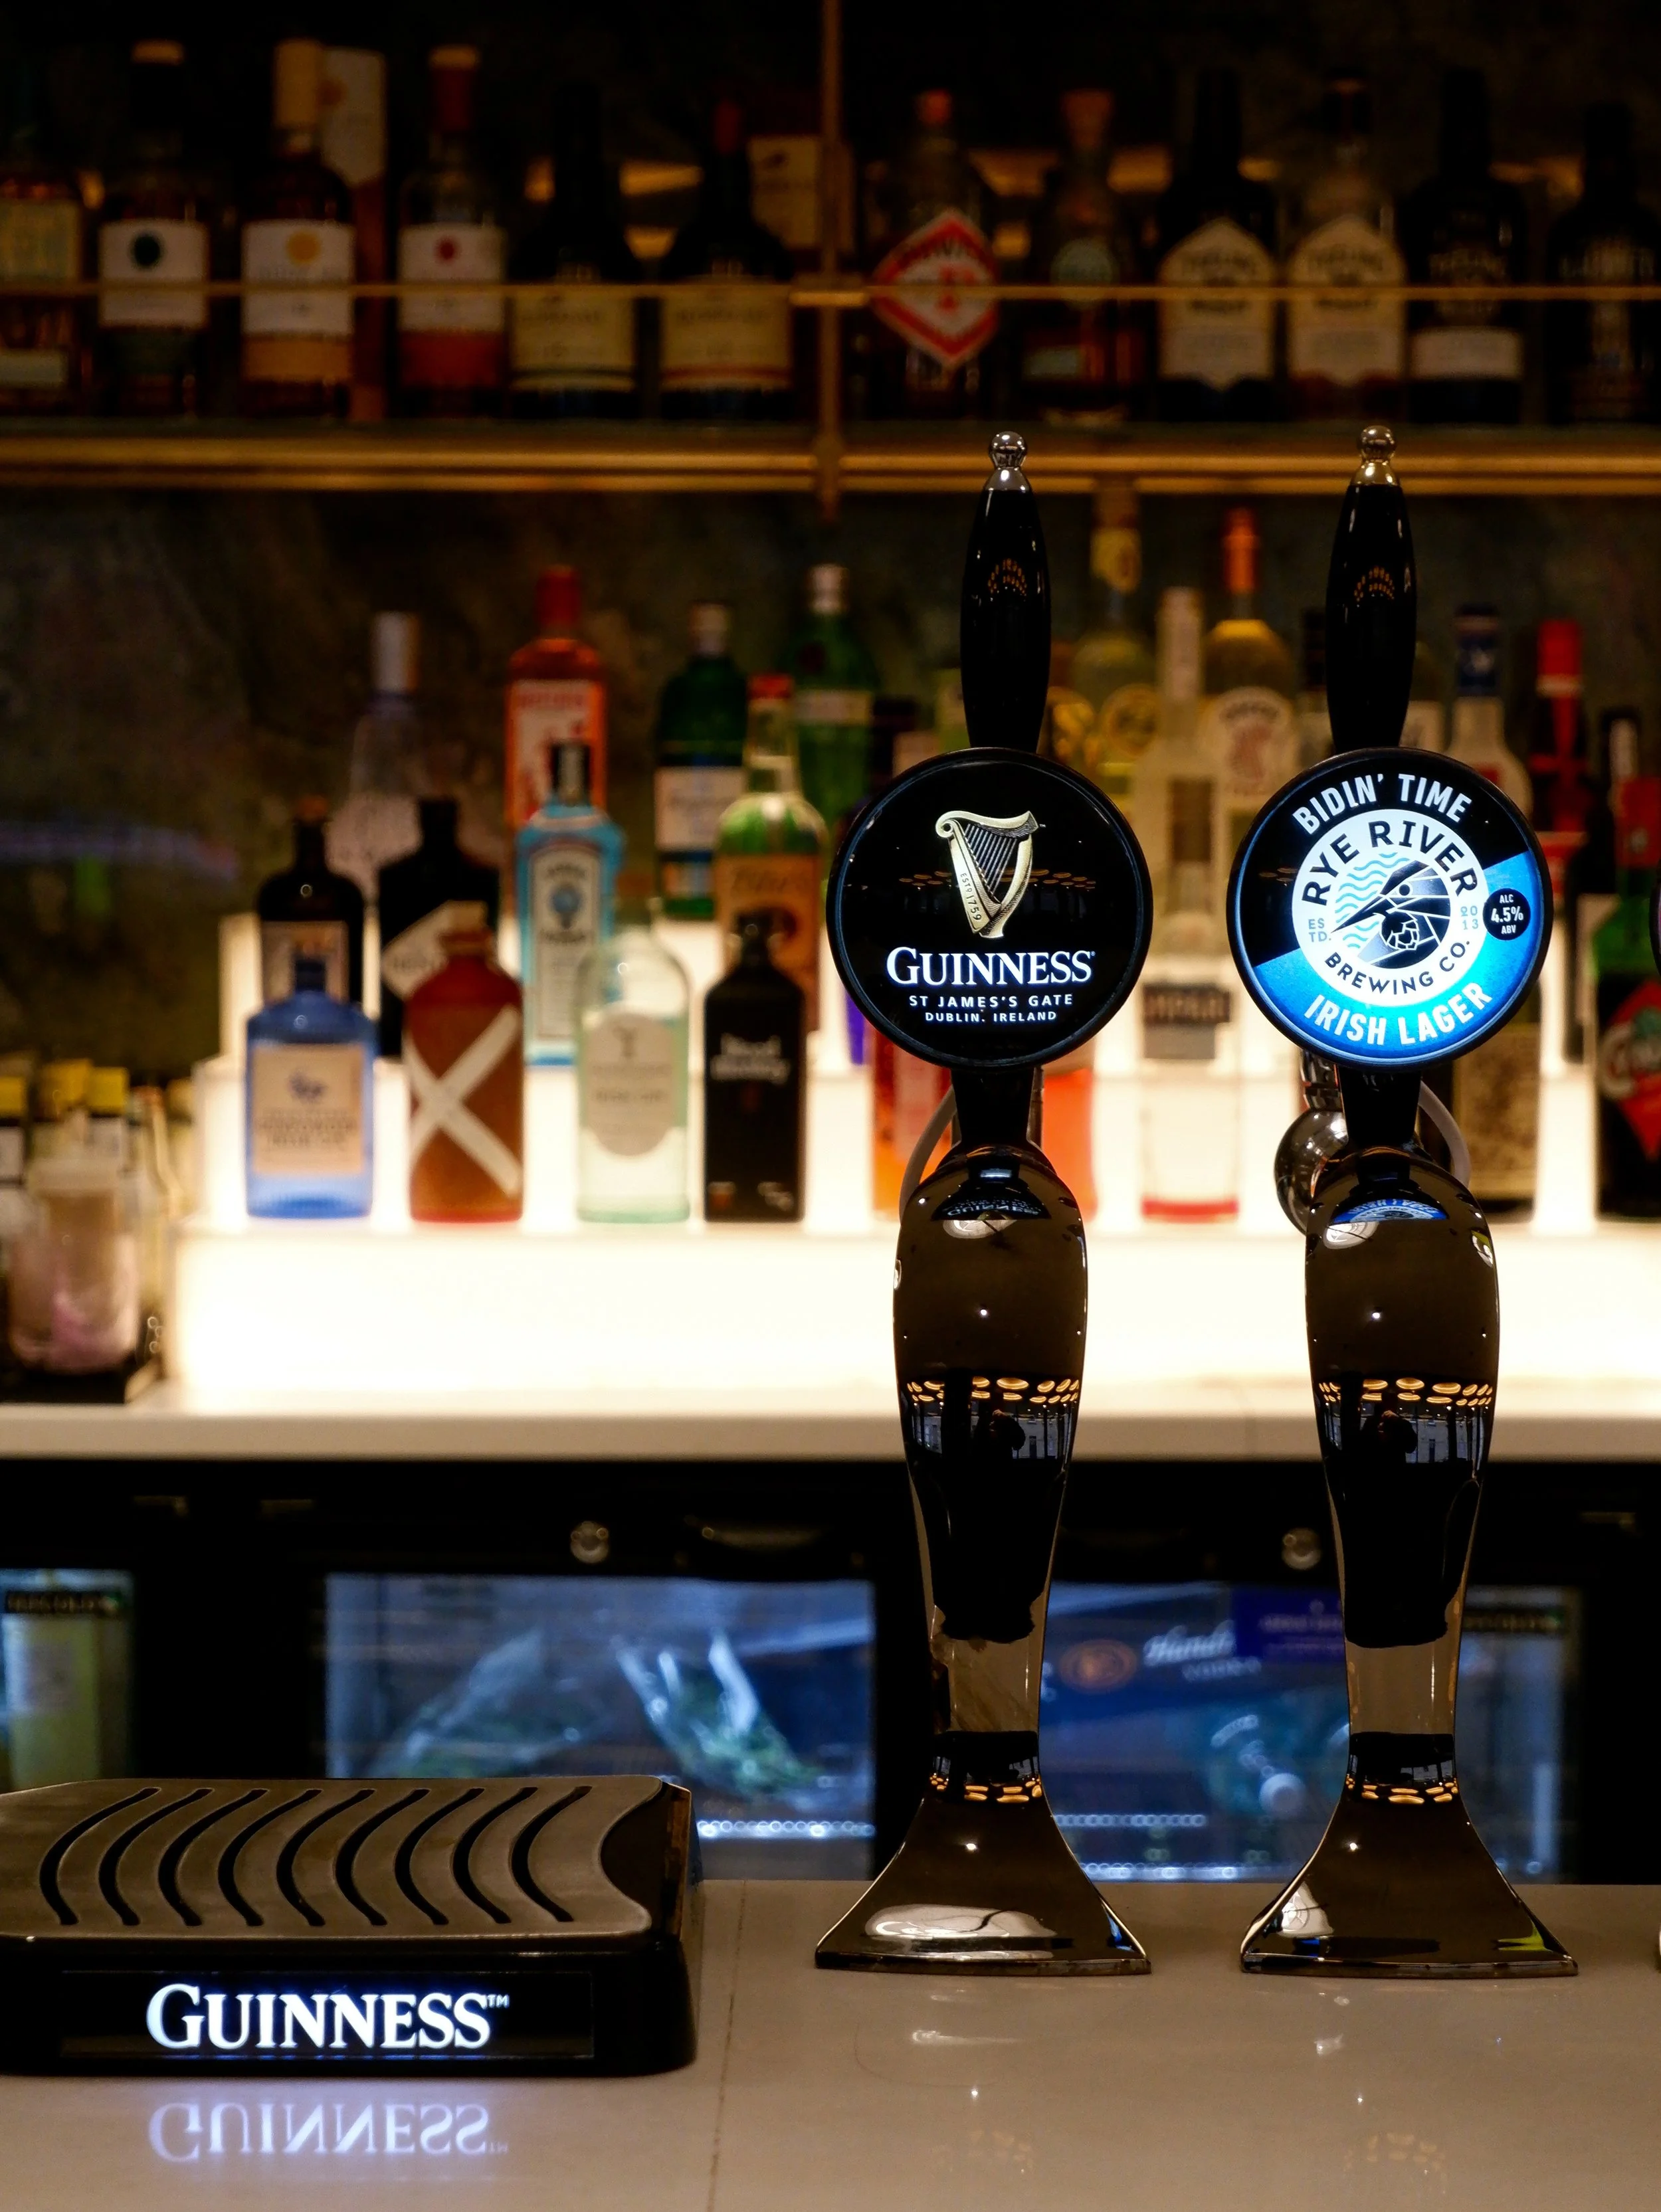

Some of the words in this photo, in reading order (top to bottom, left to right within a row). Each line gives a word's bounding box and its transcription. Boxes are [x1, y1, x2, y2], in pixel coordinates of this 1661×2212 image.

[1292, 773, 1384, 835] BIDIN'
[1398, 773, 1473, 823] TIME
[1301, 833, 1360, 906] RYE
[1368, 820, 1478, 897] RIVER
[1499, 893, 1514, 904] ALC
[966, 896, 983, 921] 1759
[1460, 905, 1478, 917] 20
[1490, 905, 1524, 923] 4.5%
[1308, 917, 1325, 930] ES
[1462, 918, 1480, 931] 13
[1501, 924, 1517, 935] ABV
[1324, 951, 1434, 995] BREWING
[1438, 940, 1470, 972] CO.
[908, 995, 928, 1007] ST
[937, 996, 1018, 1008] JAMES'S
[1028, 994, 1073, 1007] GATE
[993, 1010, 1056, 1022] IRELAND
[1304, 994, 1387, 1046] IRISH
[1397, 982, 1493, 1046] LAGER
